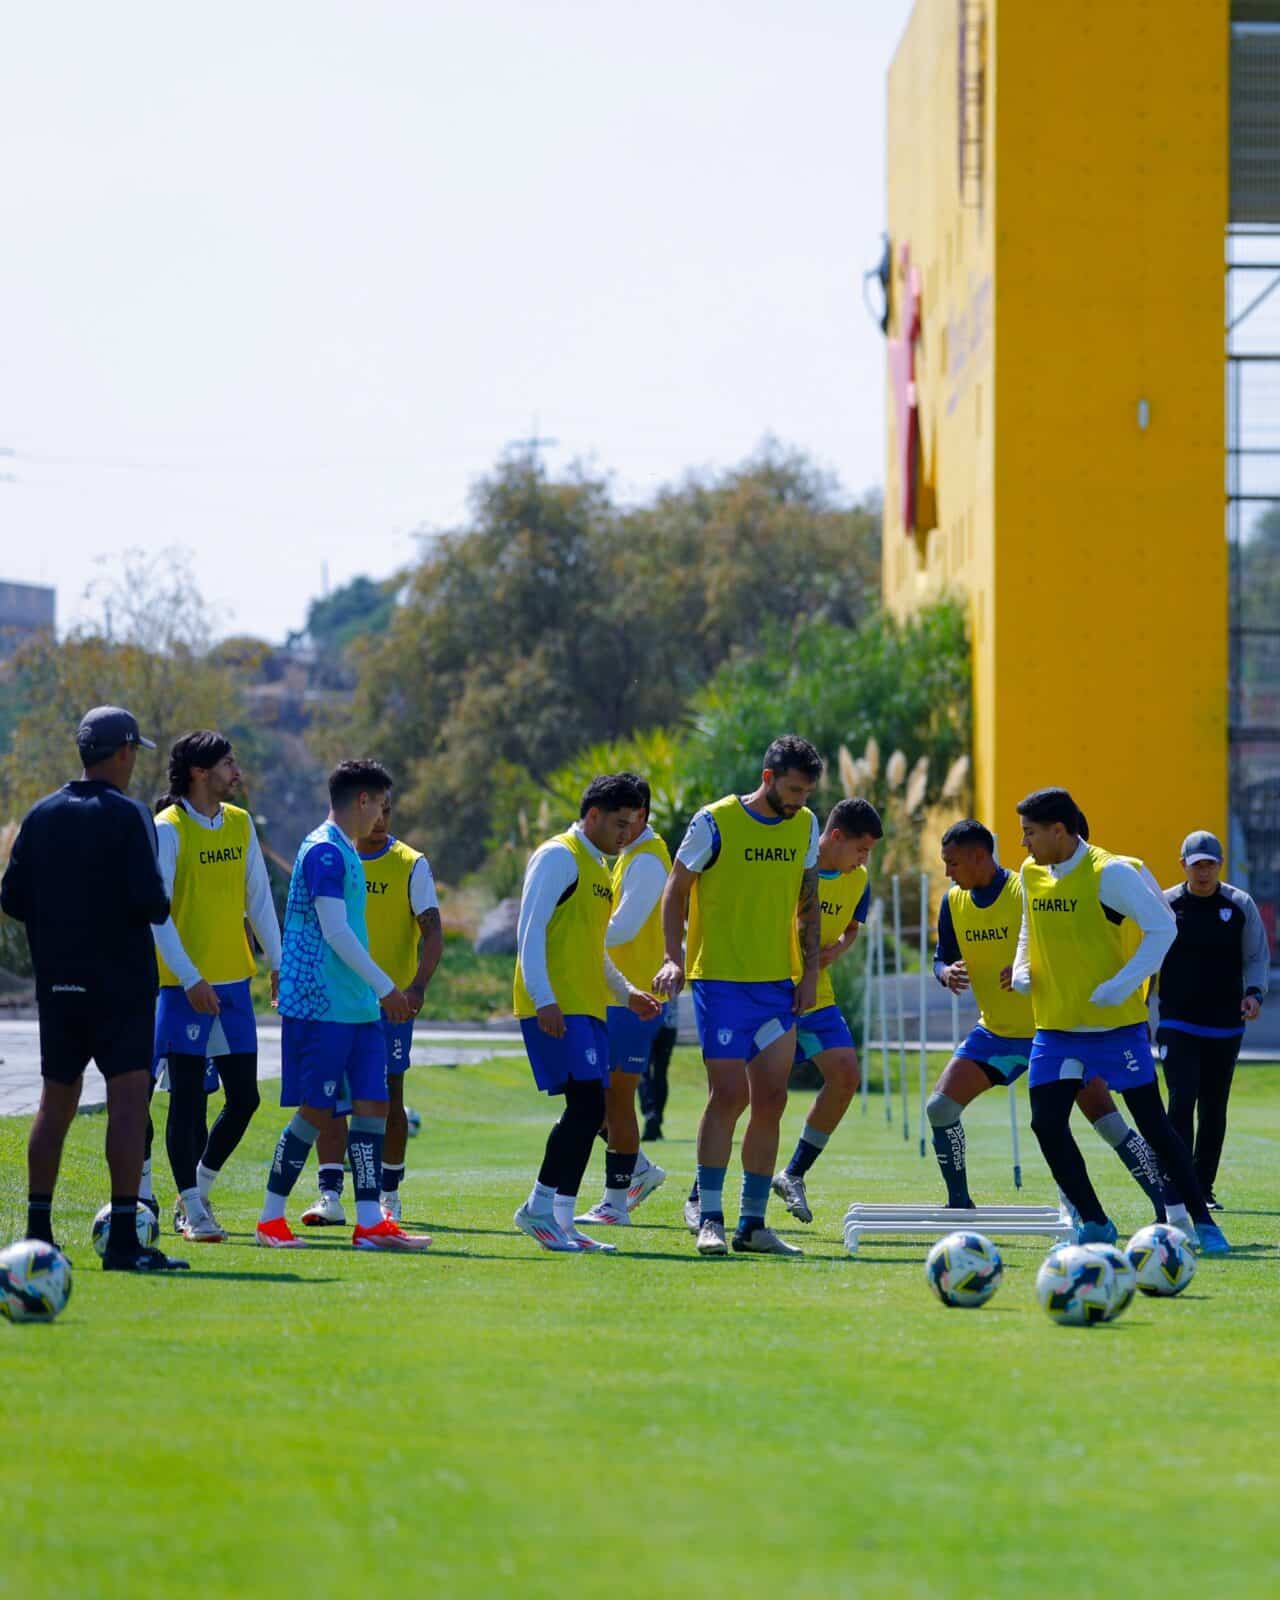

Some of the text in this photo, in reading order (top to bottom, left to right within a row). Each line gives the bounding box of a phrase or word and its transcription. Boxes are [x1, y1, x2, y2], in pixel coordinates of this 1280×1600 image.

[199, 847, 243, 865] CHARLY
[744, 848, 797, 861] CHARLY
[365, 881, 389, 894] RLY
[820, 901, 843, 915] RLY
[1032, 899, 1078, 912] CHARLY
[965, 927, 1009, 942] CHARLY
